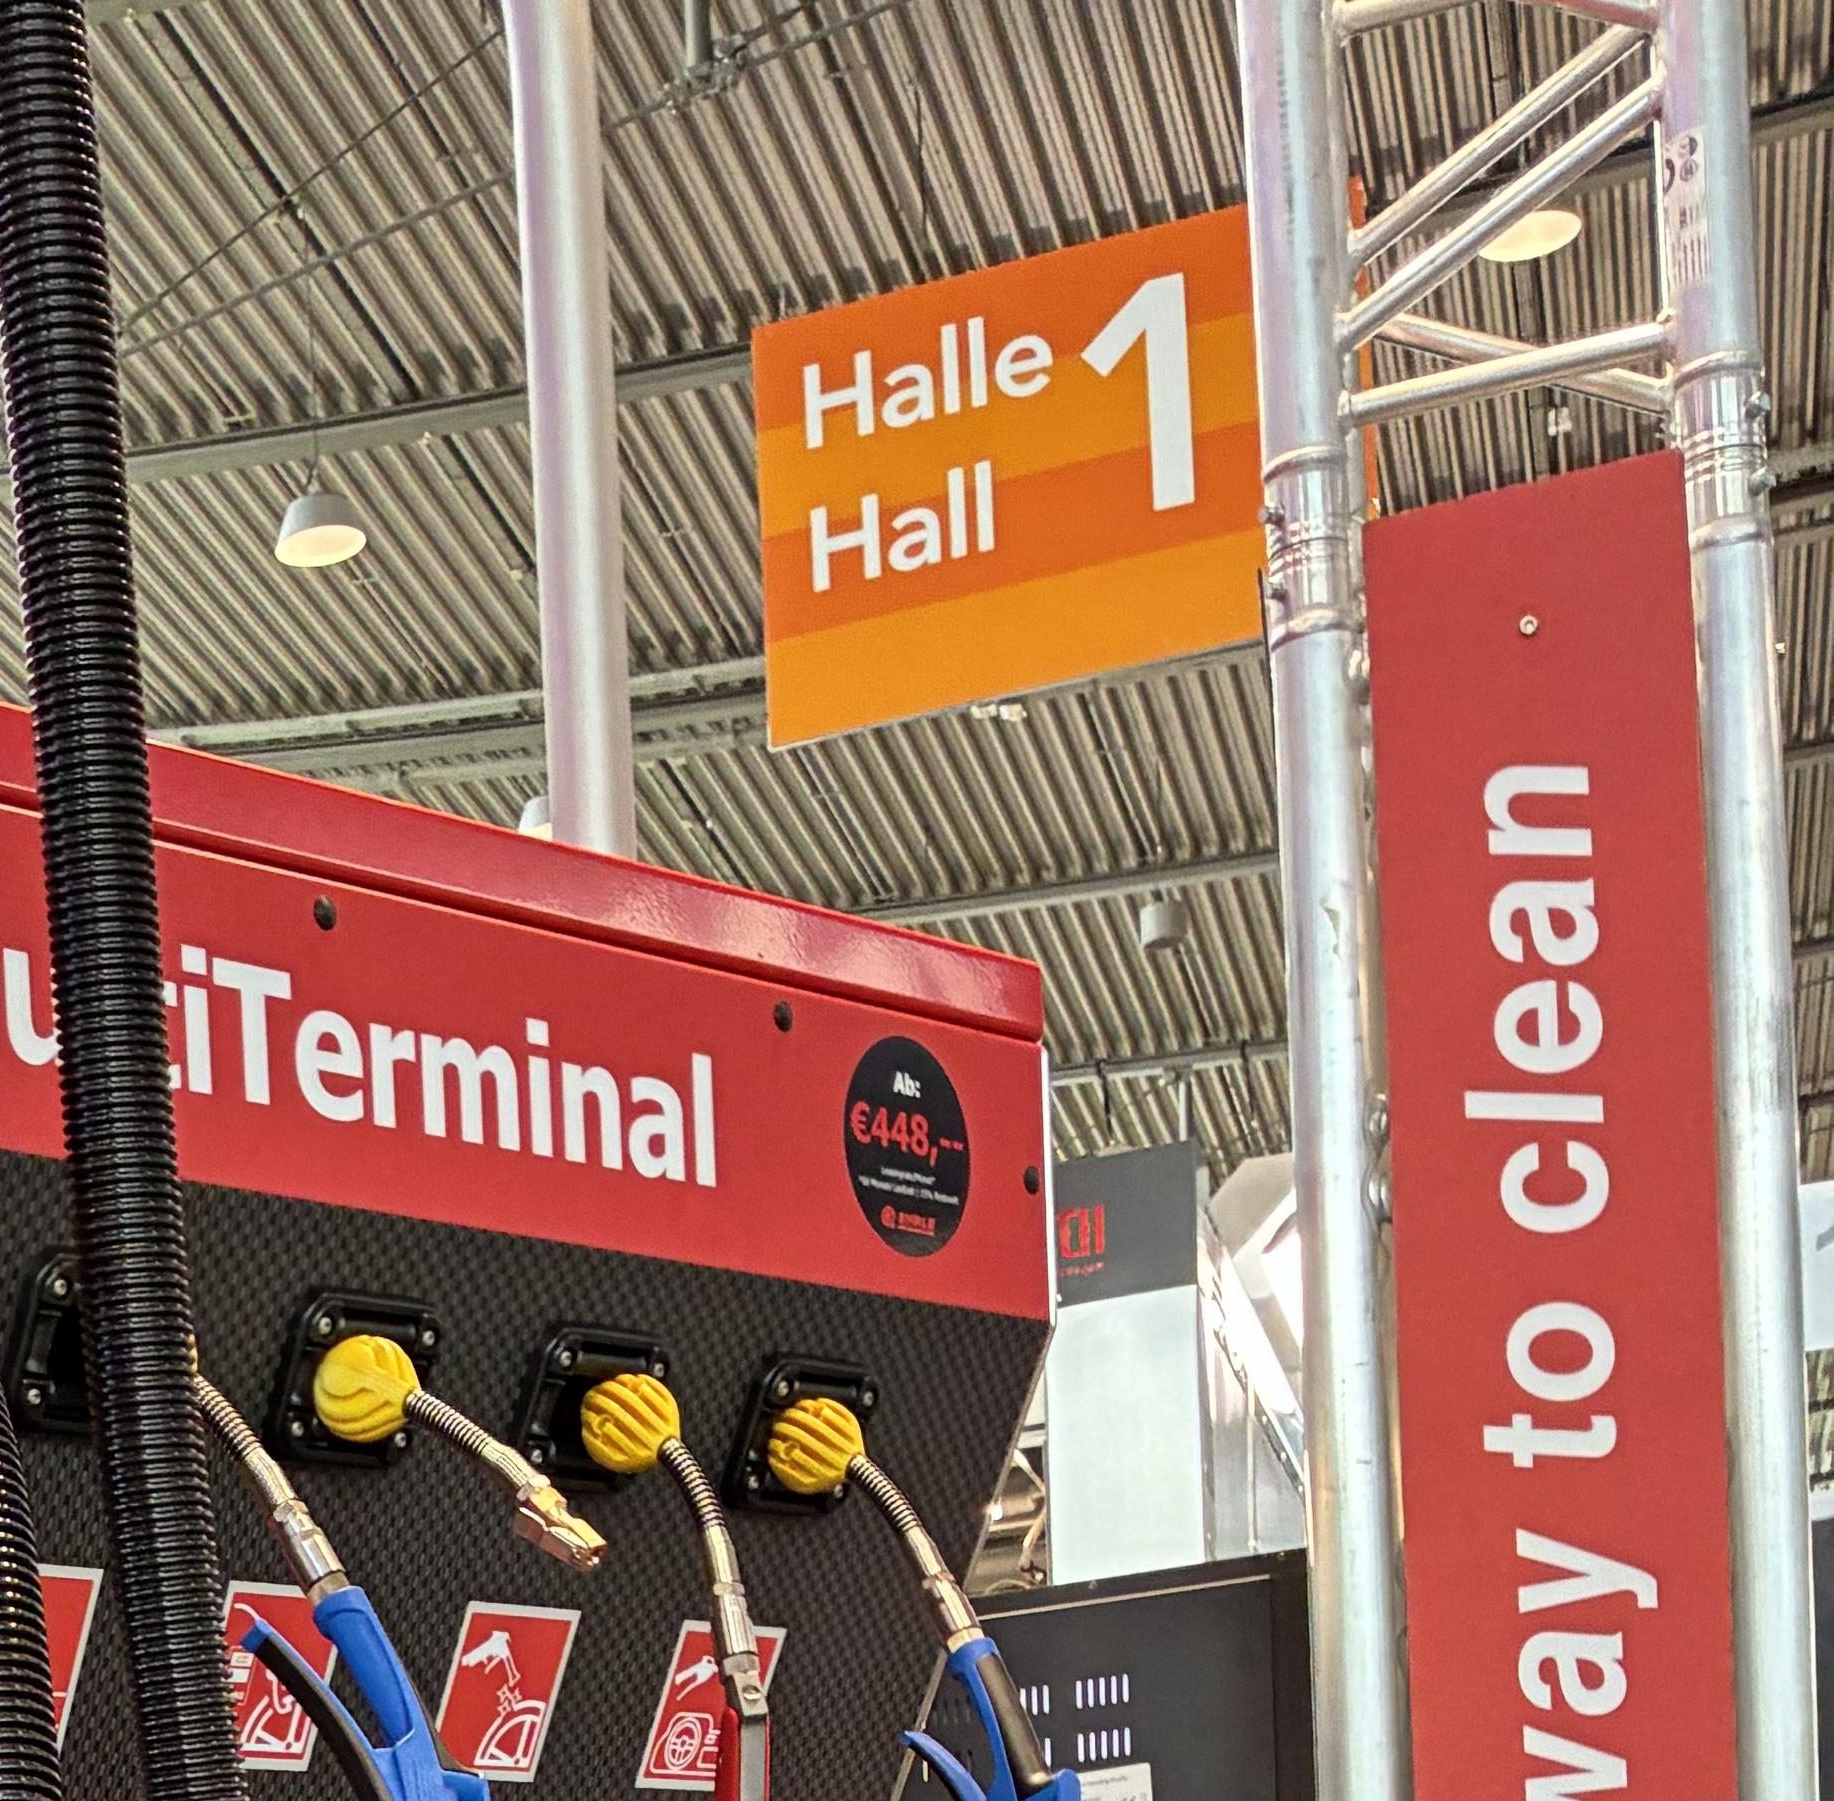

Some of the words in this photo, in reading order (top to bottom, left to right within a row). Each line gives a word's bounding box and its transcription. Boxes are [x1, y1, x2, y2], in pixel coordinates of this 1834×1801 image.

[802, 315, 1054, 450] Halle
[1080, 272, 1195, 511] 1
[809, 460, 995, 592] Hall
[1464, 764, 1611, 1234] clean
[1482, 1301, 1619, 1467] to
